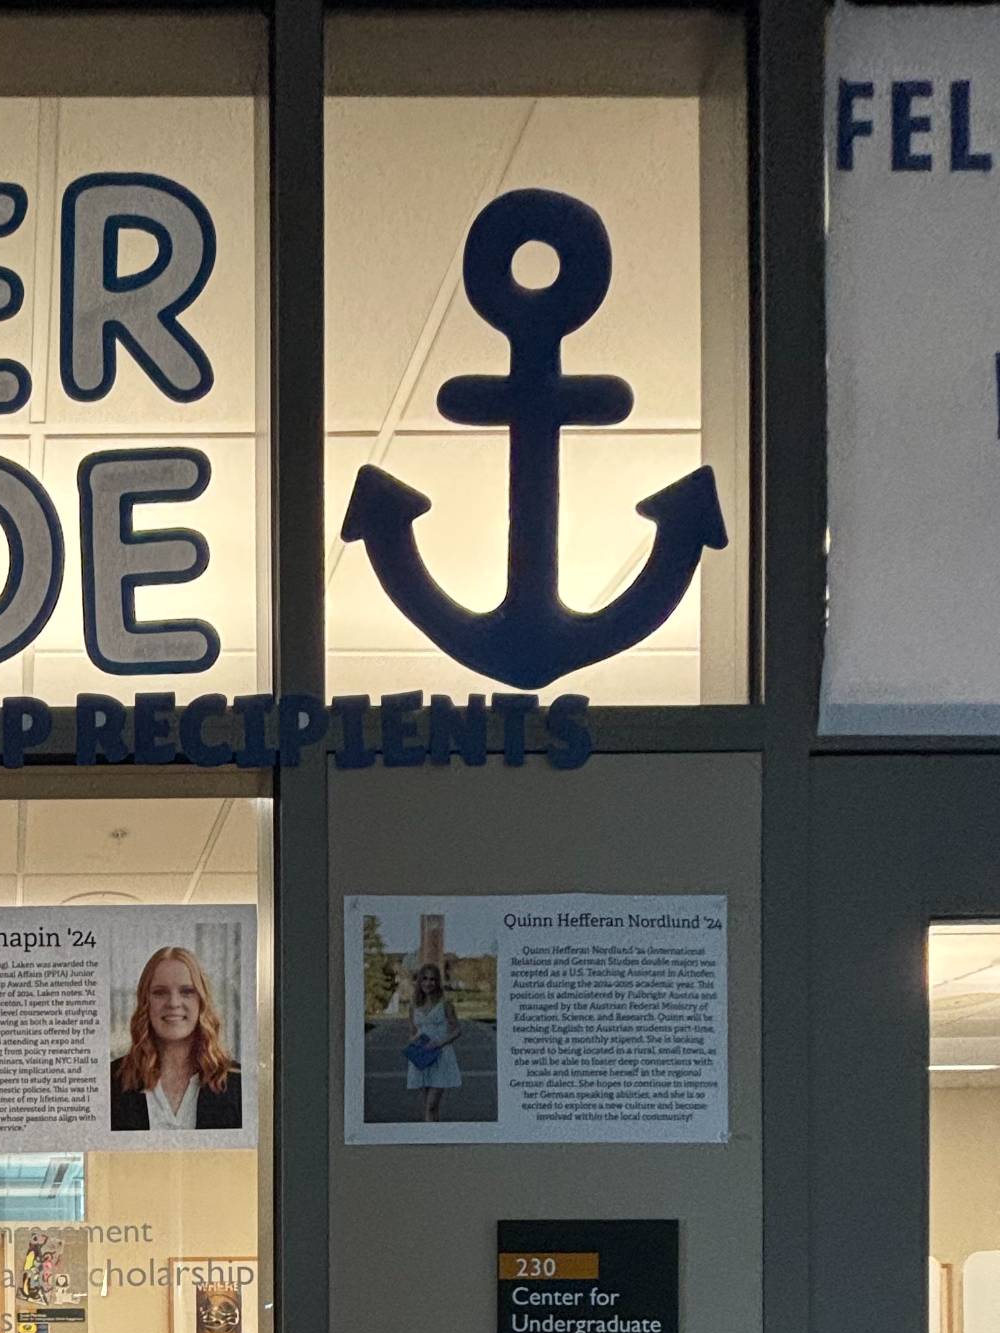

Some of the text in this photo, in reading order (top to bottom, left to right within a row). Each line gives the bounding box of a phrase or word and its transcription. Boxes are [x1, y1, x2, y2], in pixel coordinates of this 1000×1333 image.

[76, 691, 591, 770] RECIPIENTS
[503, 912, 724, 931] Quinn Hefferan Nordlund '24
[67, 927, 97, 949] '24
[88, 1258, 254, 1295] cholarship
[515, 1258, 557, 1277] 230
[512, 1286, 620, 1307] Center for
